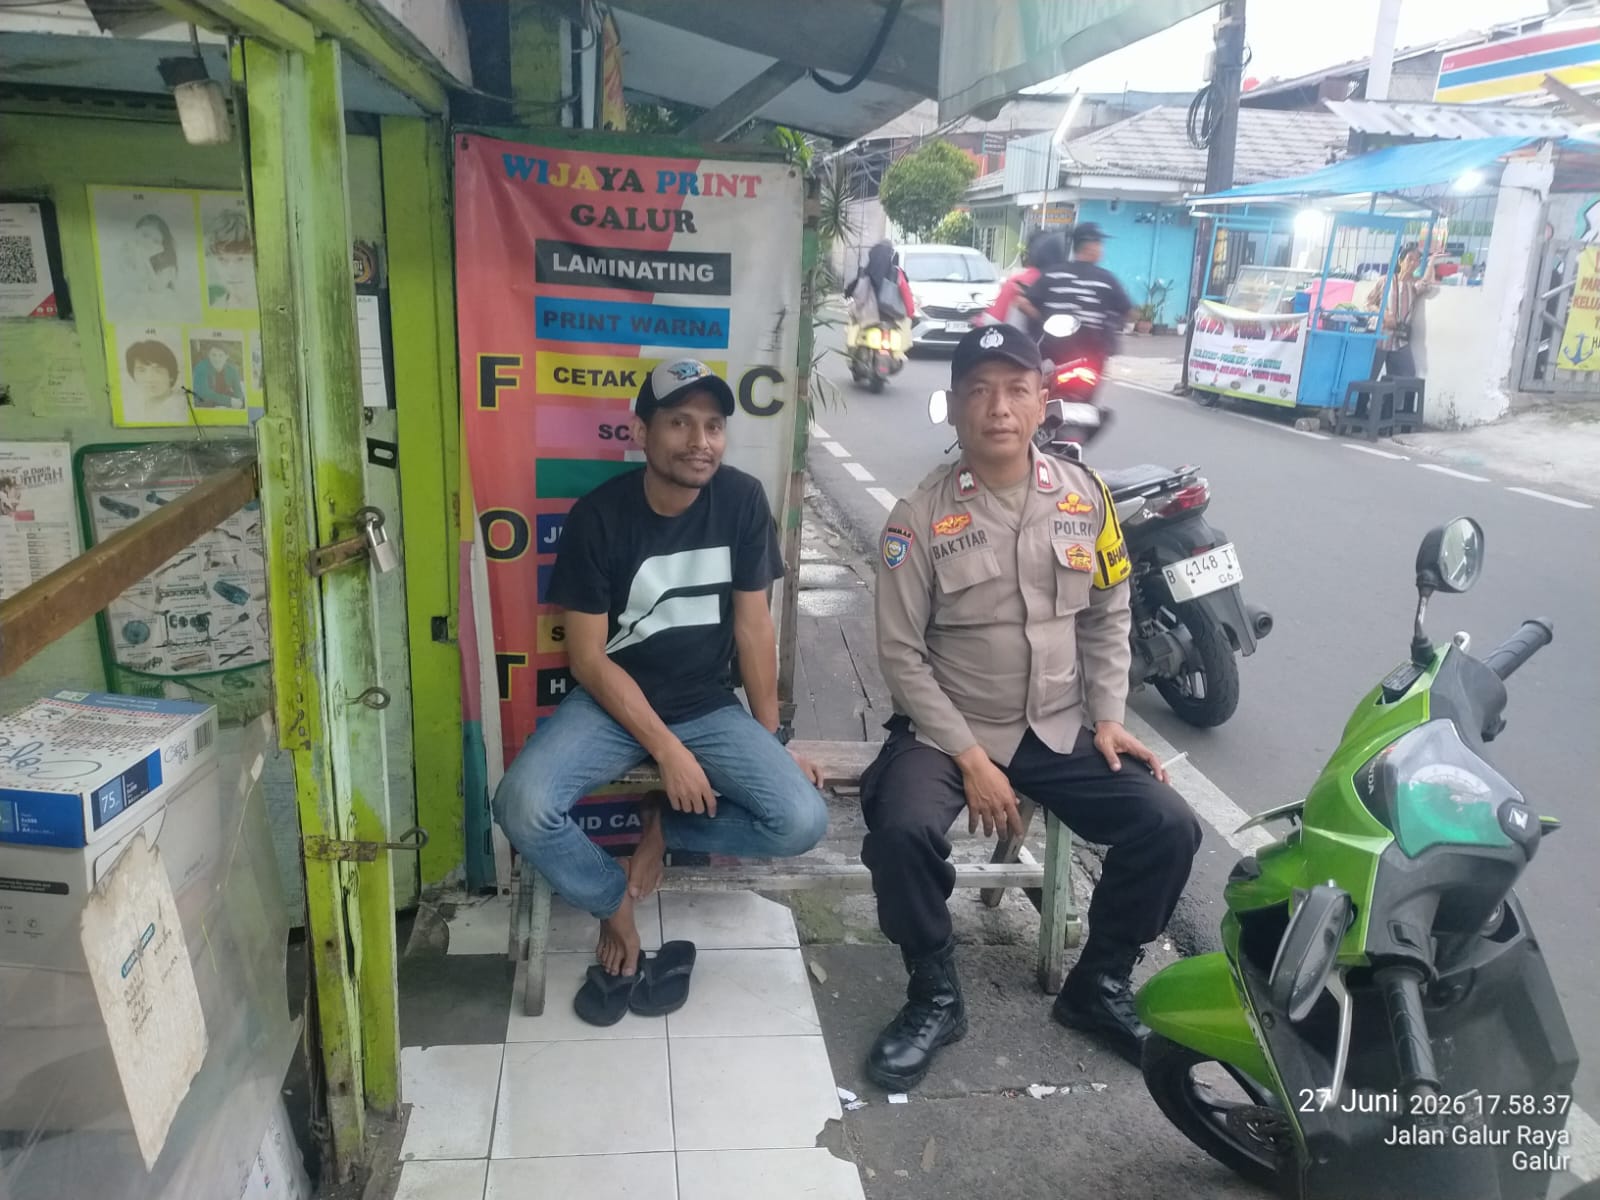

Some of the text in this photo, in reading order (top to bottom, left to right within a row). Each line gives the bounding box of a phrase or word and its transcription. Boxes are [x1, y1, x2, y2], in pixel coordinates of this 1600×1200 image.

[502, 153, 762, 199] WIJAYA PRINT
[570, 204, 697, 234] GALUR
[553, 253, 714, 283] LAMINATING
[543, 310, 723, 337] PRINT WARNA
[477, 353, 522, 411] F
[553, 367, 637, 388] CETAK
[738, 365, 785, 417] C
[480, 508, 530, 562] O
[1054, 520, 1092, 537] POLRI
[932, 529, 988, 560] BAKTIAR
[1165, 569, 1177, 585] B
[1185, 554, 1218, 577] 4148
[101, 791, 116, 814] 75
